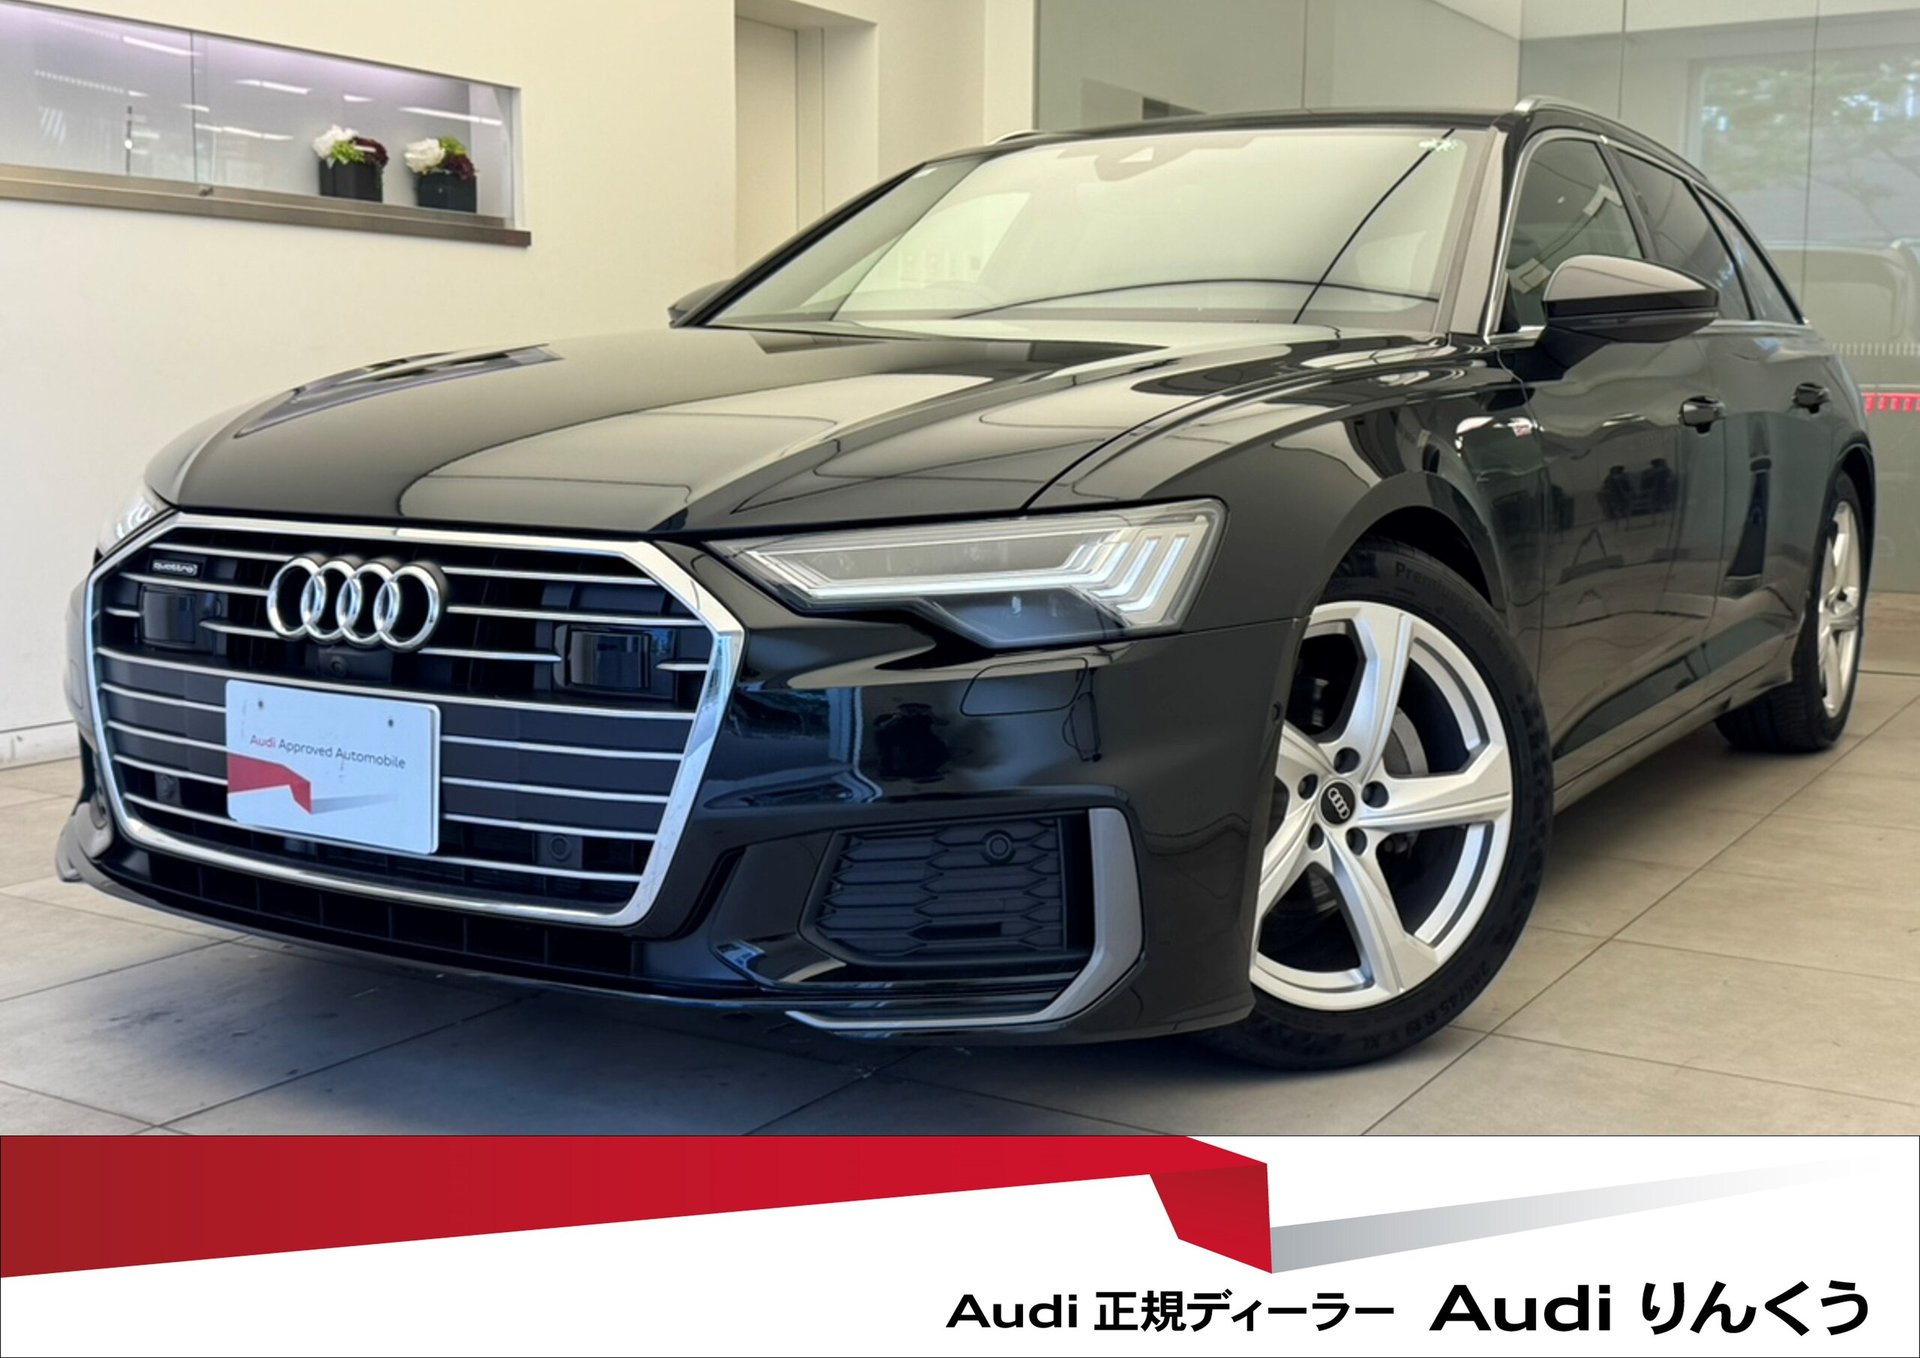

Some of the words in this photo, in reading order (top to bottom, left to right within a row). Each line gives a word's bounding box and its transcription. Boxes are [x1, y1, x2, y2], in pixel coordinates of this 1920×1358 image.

[250, 734, 276, 748] Audi
[279, 738, 333, 759] Approved
[335, 747, 406, 769] Automobile
